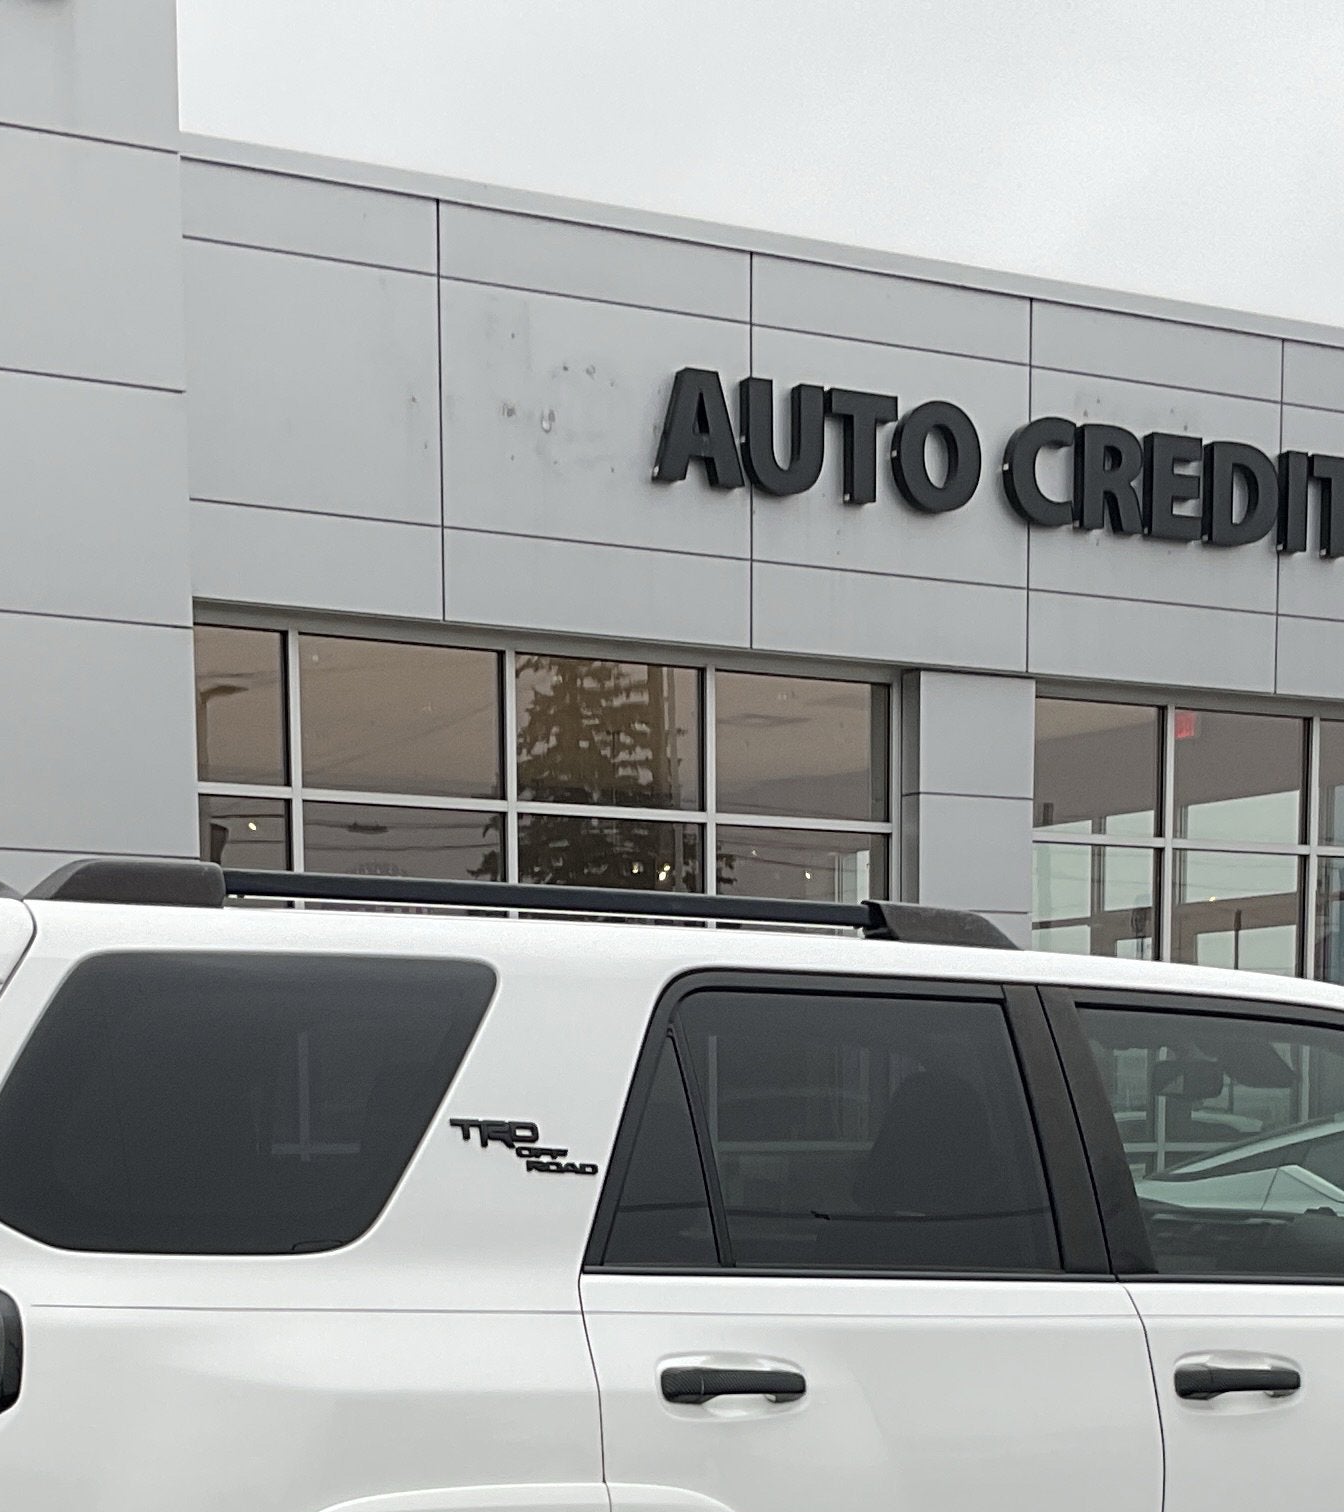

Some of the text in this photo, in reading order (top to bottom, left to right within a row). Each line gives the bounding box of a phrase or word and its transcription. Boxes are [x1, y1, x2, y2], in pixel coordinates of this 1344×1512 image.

[651, 367, 982, 513] AUTO
[449, 1118, 540, 1149] TRD
[526, 1160, 599, 1176] ROAD
